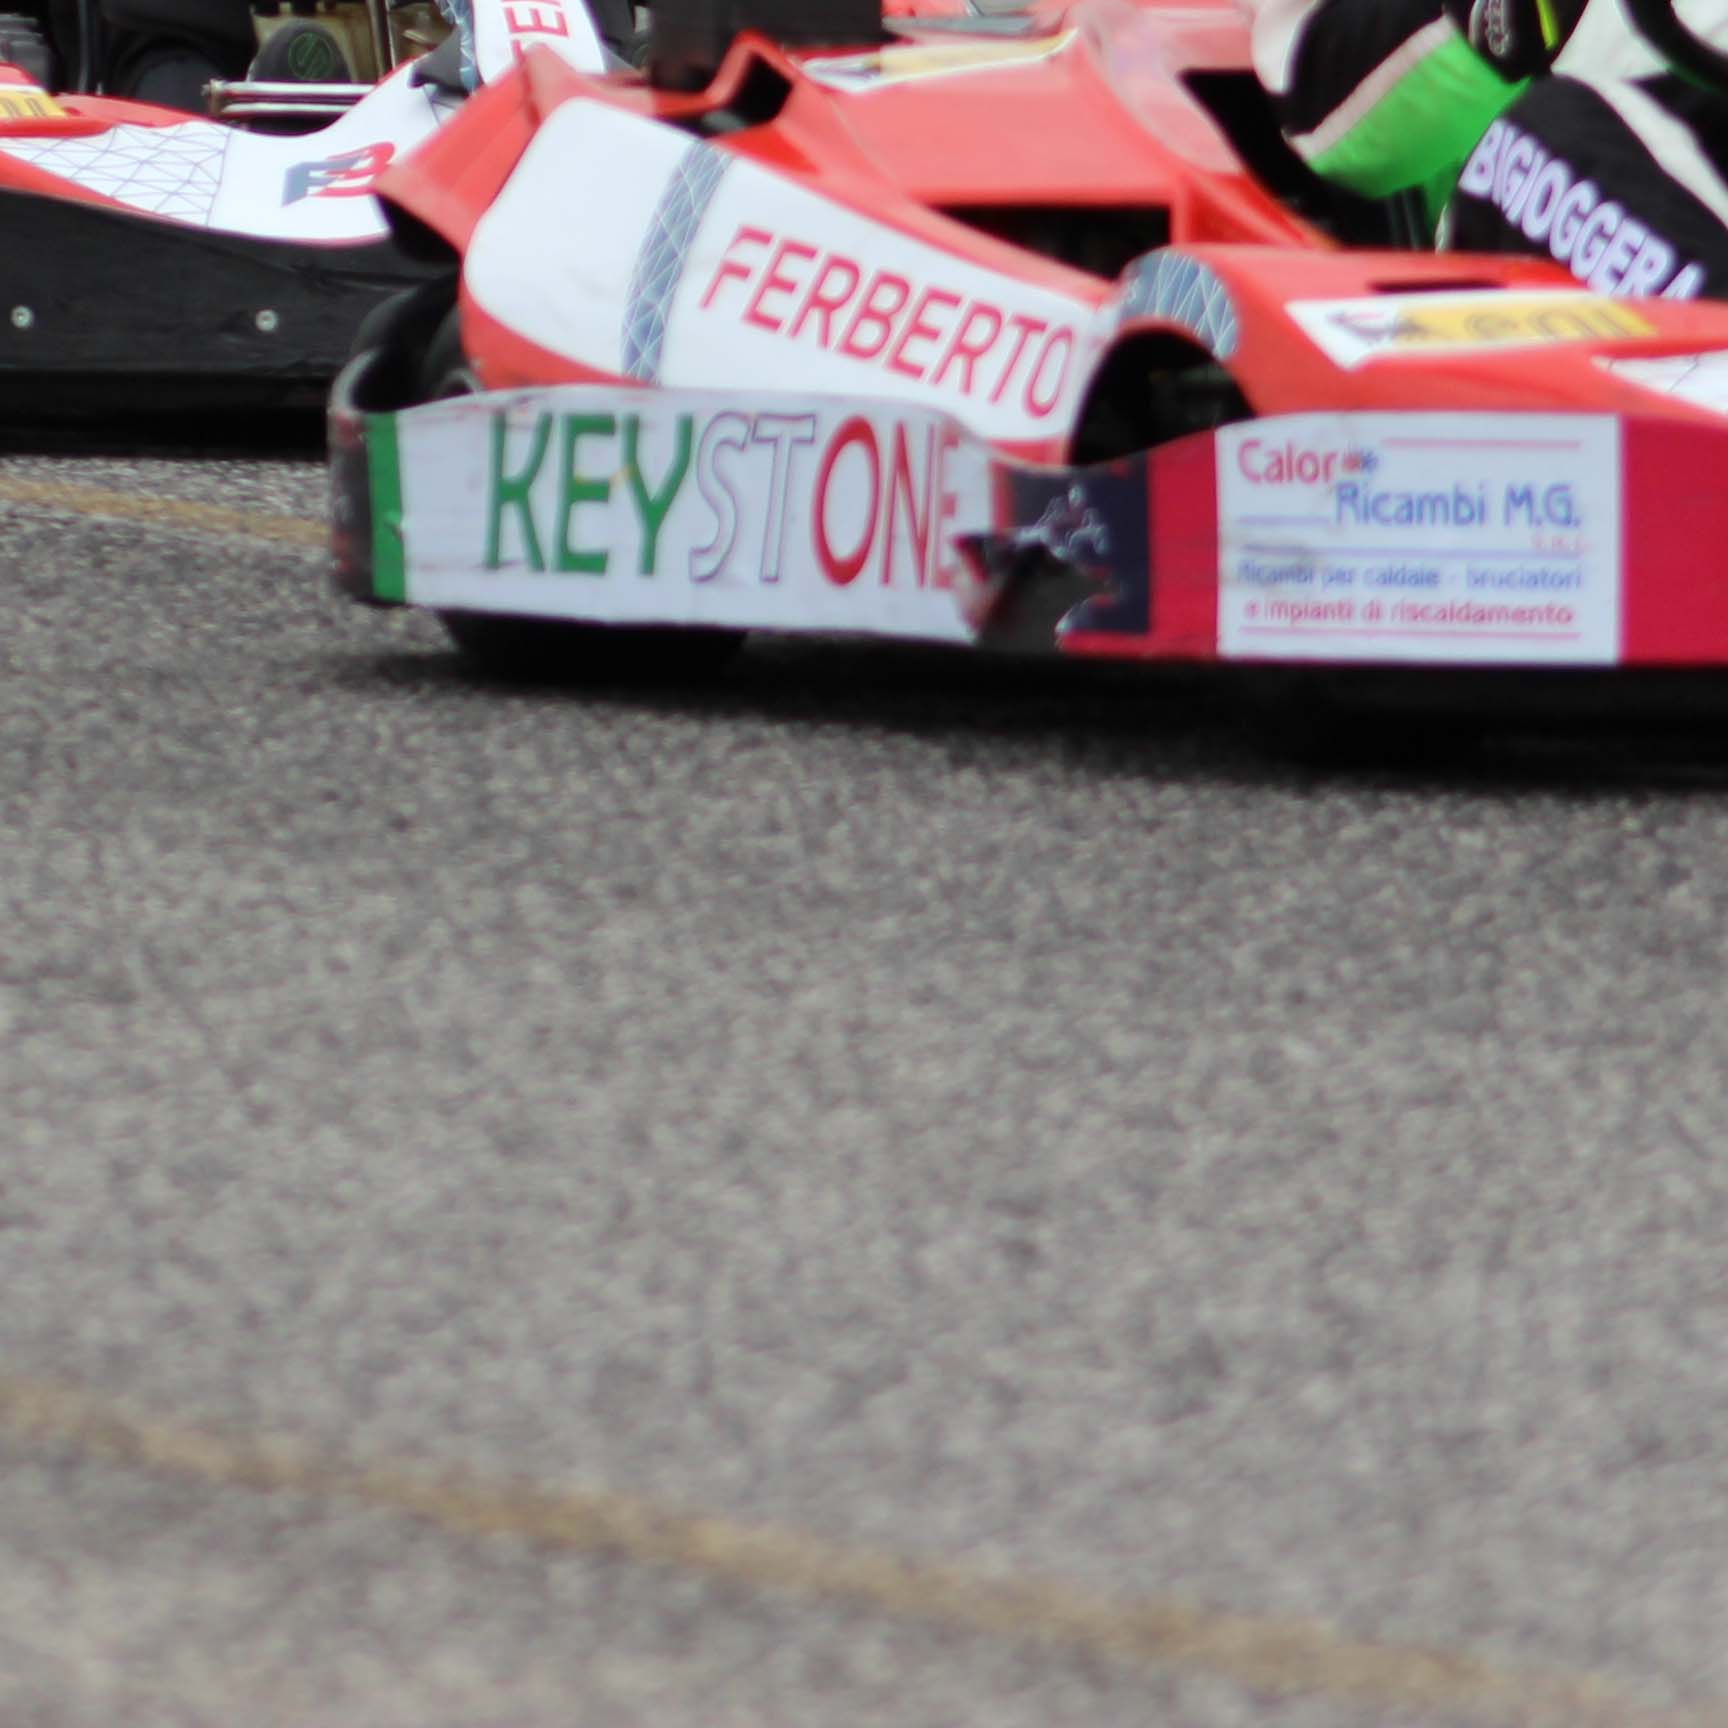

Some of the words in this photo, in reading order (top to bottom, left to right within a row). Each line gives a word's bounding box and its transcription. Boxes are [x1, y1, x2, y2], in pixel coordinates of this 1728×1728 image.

[701, 224, 1075, 419] FERBERTO
[1238, 439, 1338, 485] Calor
[484, 410, 960, 592] KEYSTONE
[1334, 480, 1486, 526] Ricambi
[1505, 483, 1580, 528] M.G.
[1390, 600, 1576, 624] riscaldamento
